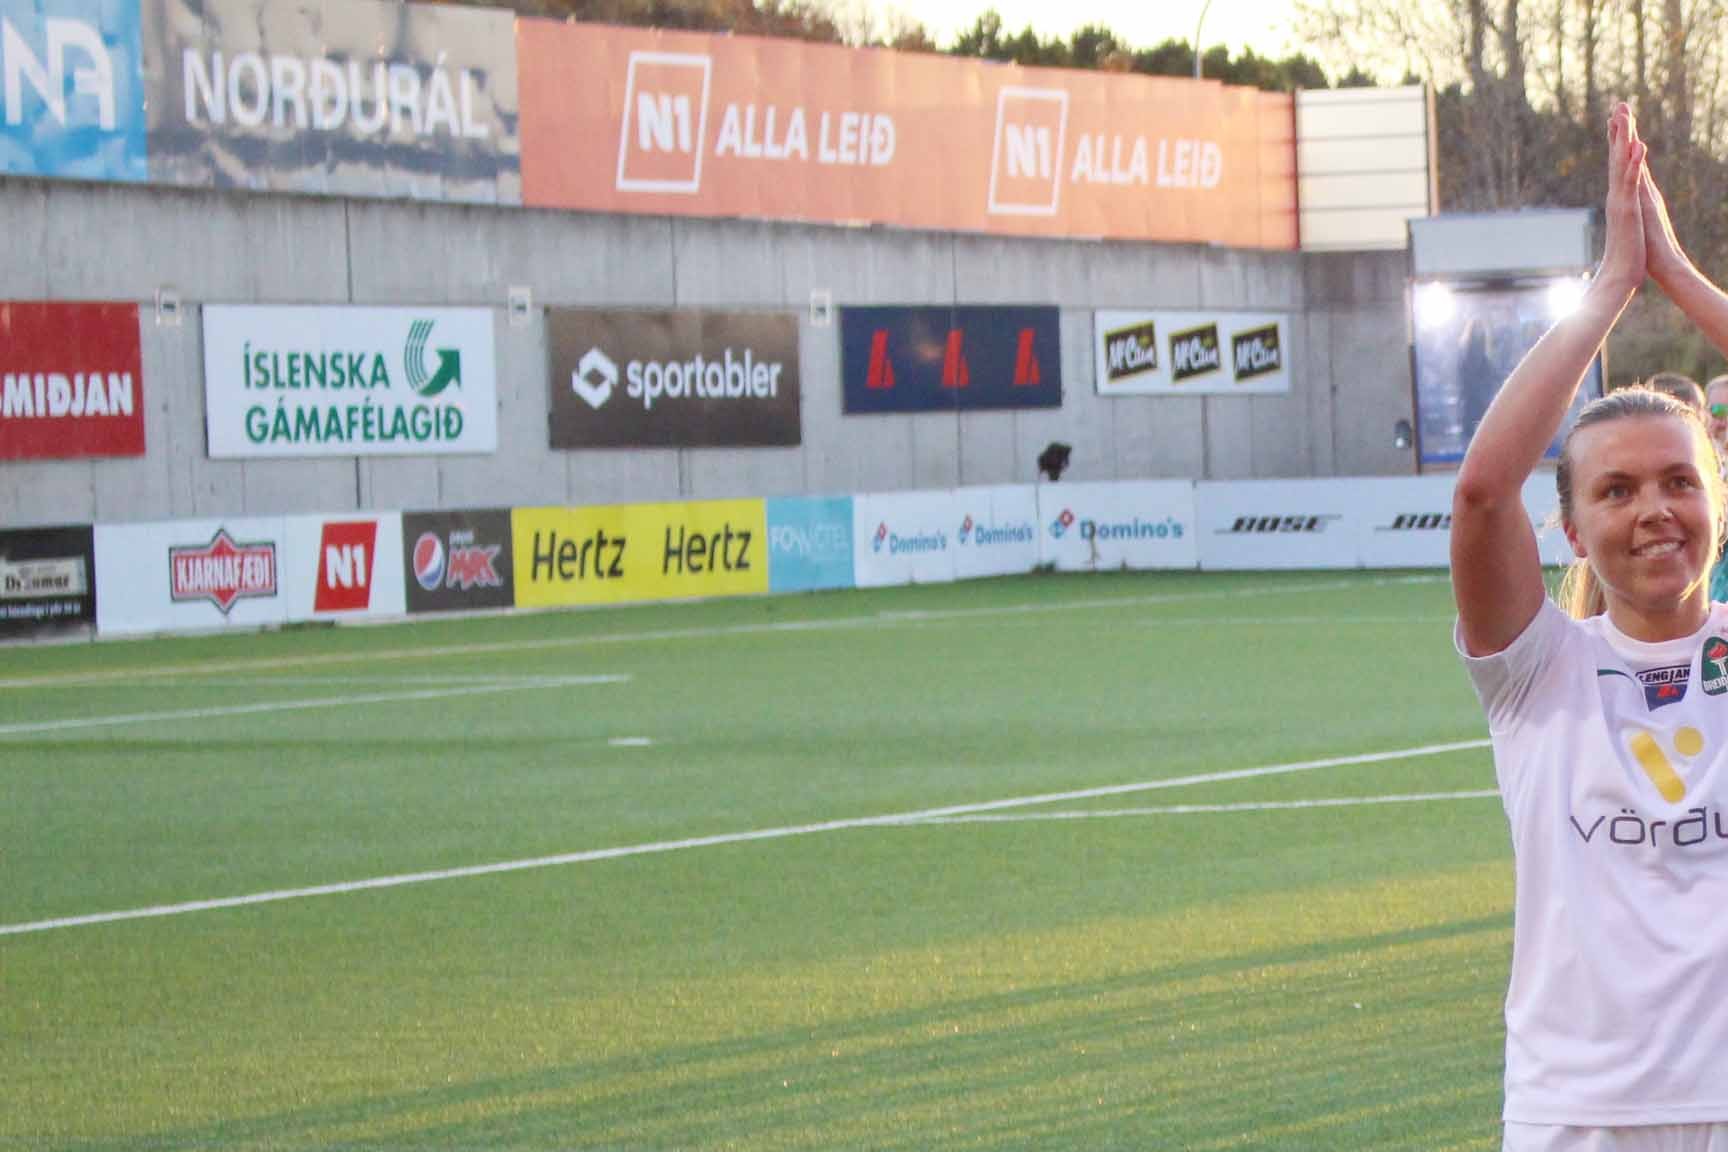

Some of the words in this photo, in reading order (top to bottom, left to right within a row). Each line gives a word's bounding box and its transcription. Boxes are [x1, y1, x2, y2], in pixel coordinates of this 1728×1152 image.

[183, 47, 489, 139] NORÐURÁL
[637, 91, 692, 152] N1
[715, 103, 808, 159] ALLA
[818, 112, 896, 166] LEIÐ
[1006, 124, 1051, 178] N1
[1072, 134, 1149, 184] ALLA
[243, 340, 392, 389] ÍSLENSKA
[626, 347, 782, 410] sportabler
[0, 372, 134, 418] MIÐJAN
[244, 396, 464, 444] GÁMAFÉLAGIÐ
[889, 529, 948, 555] Domino's
[976, 521, 1033, 546] Domino's
[1079, 515, 1183, 540] Domino's
[1213, 514, 1342, 534] BOSE
[326, 546, 366, 589] N1
[531, 528, 626, 583] Hertz
[663, 522, 752, 576] Hertz
